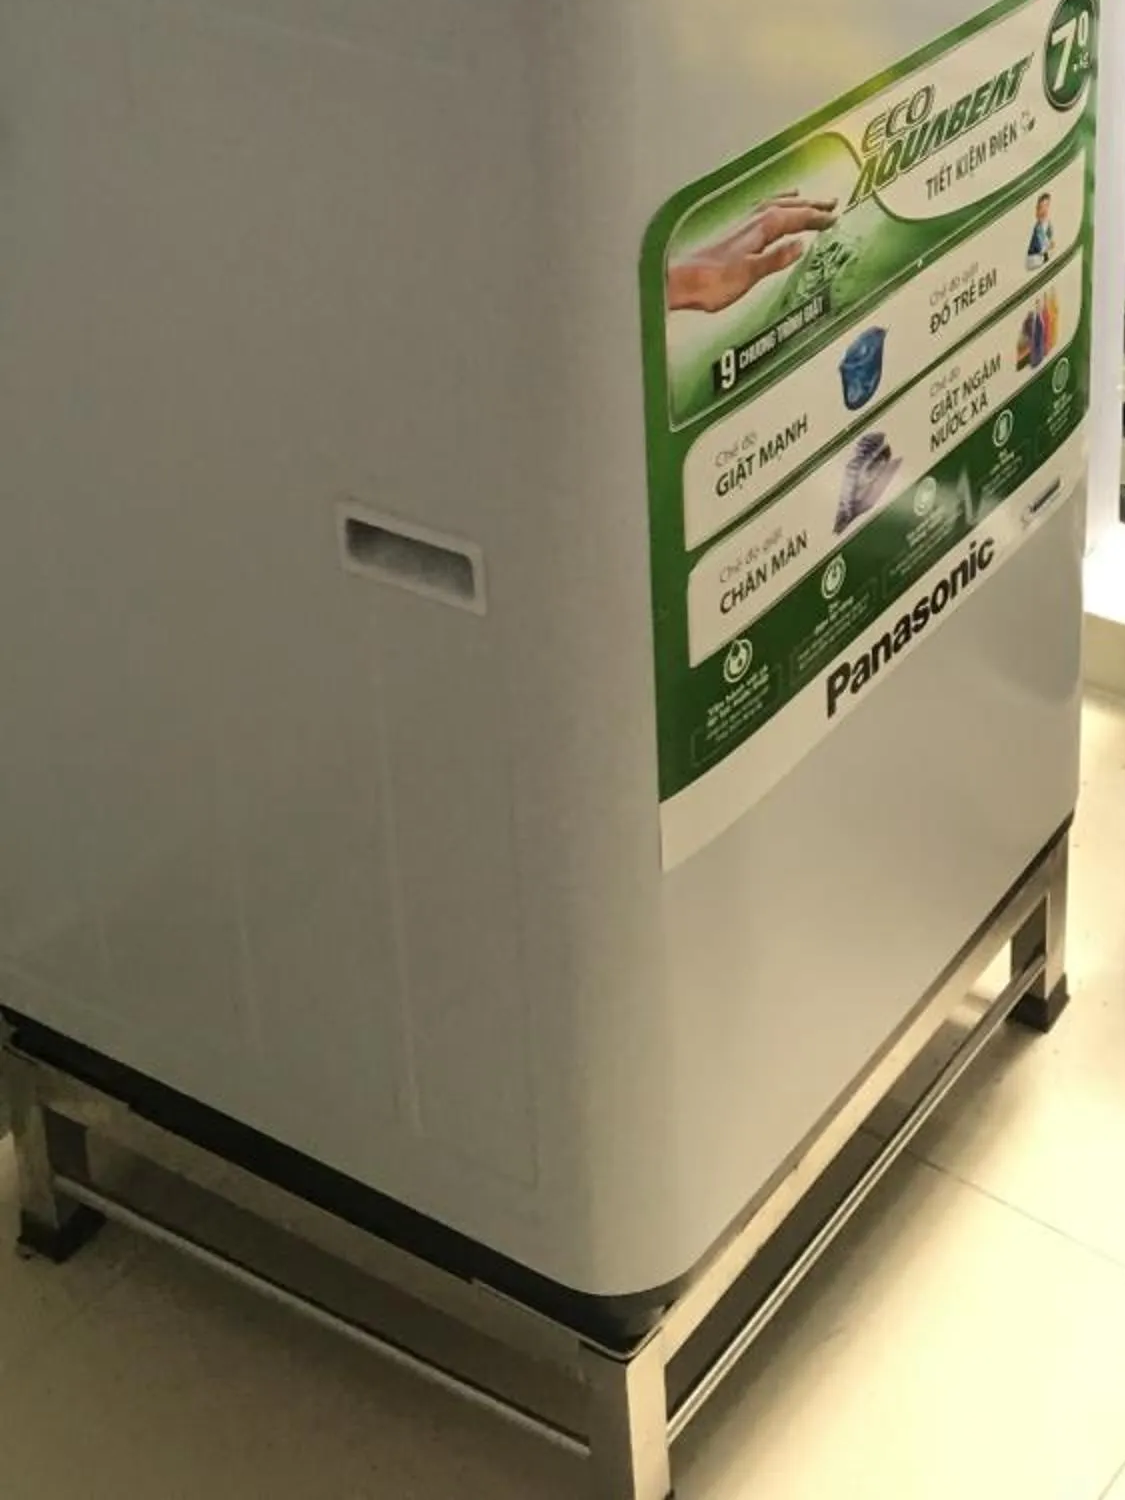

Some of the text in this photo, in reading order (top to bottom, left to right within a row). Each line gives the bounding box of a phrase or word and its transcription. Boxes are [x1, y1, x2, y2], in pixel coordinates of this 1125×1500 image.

[843, 51, 1035, 215] AQUABEAT
[861, 84, 935, 155] ECO
[979, 267, 997, 297] EM
[720, 349, 736, 389] 9
[716, 412, 808, 497] GIẶT MẠNH
[824, 536, 995, 720] Panasonic
